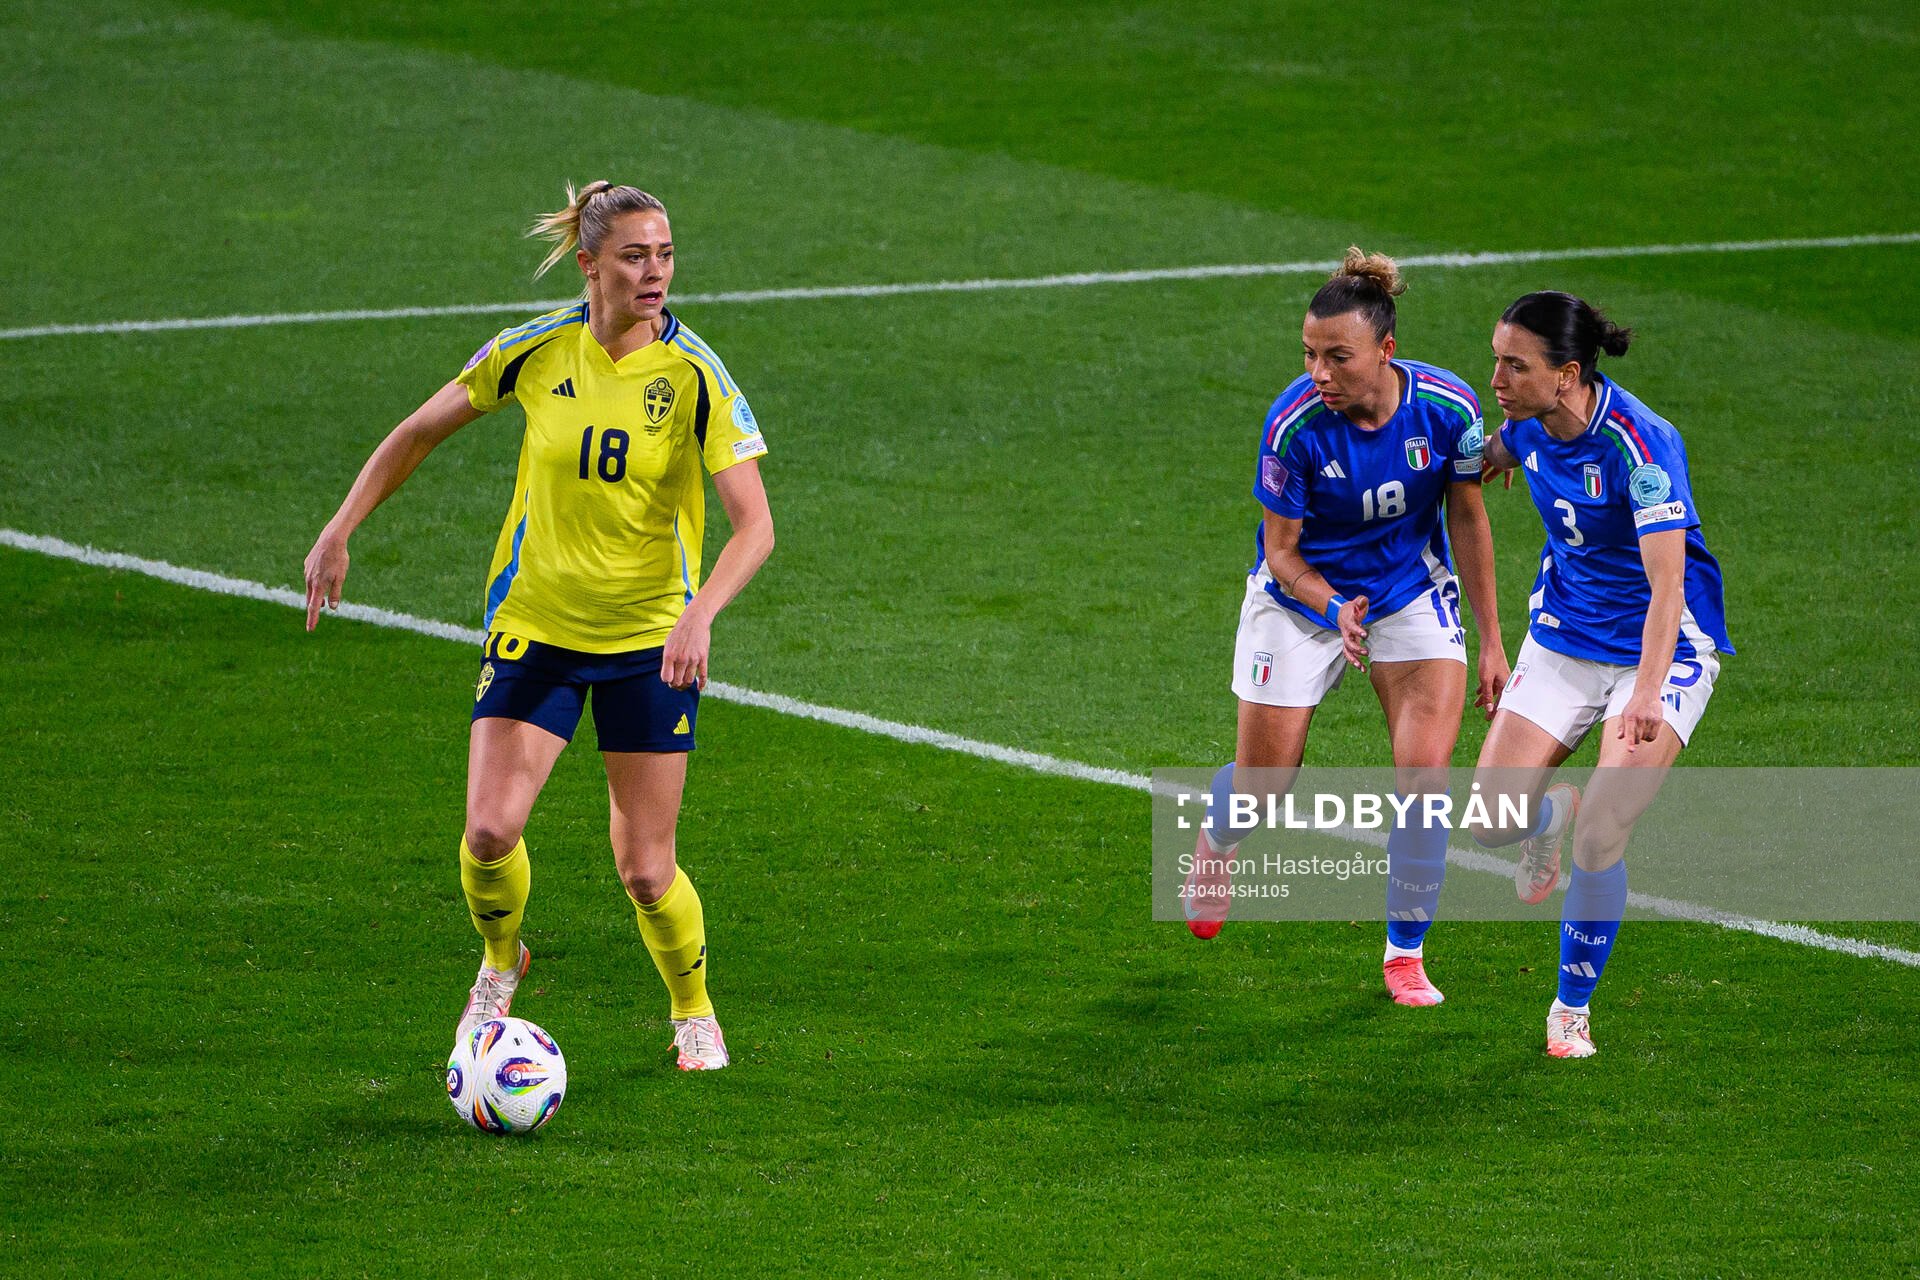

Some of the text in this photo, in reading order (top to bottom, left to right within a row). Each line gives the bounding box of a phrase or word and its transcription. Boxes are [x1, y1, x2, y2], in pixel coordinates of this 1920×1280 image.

[579, 425, 630, 483] 18
[1406, 439, 1426, 449] ITALIA
[1362, 480, 1406, 522] 18
[1553, 498, 1584, 547] 3
[1391, 876, 1439, 893] ITALIA
[1564, 922, 1608, 946] ITALIA
